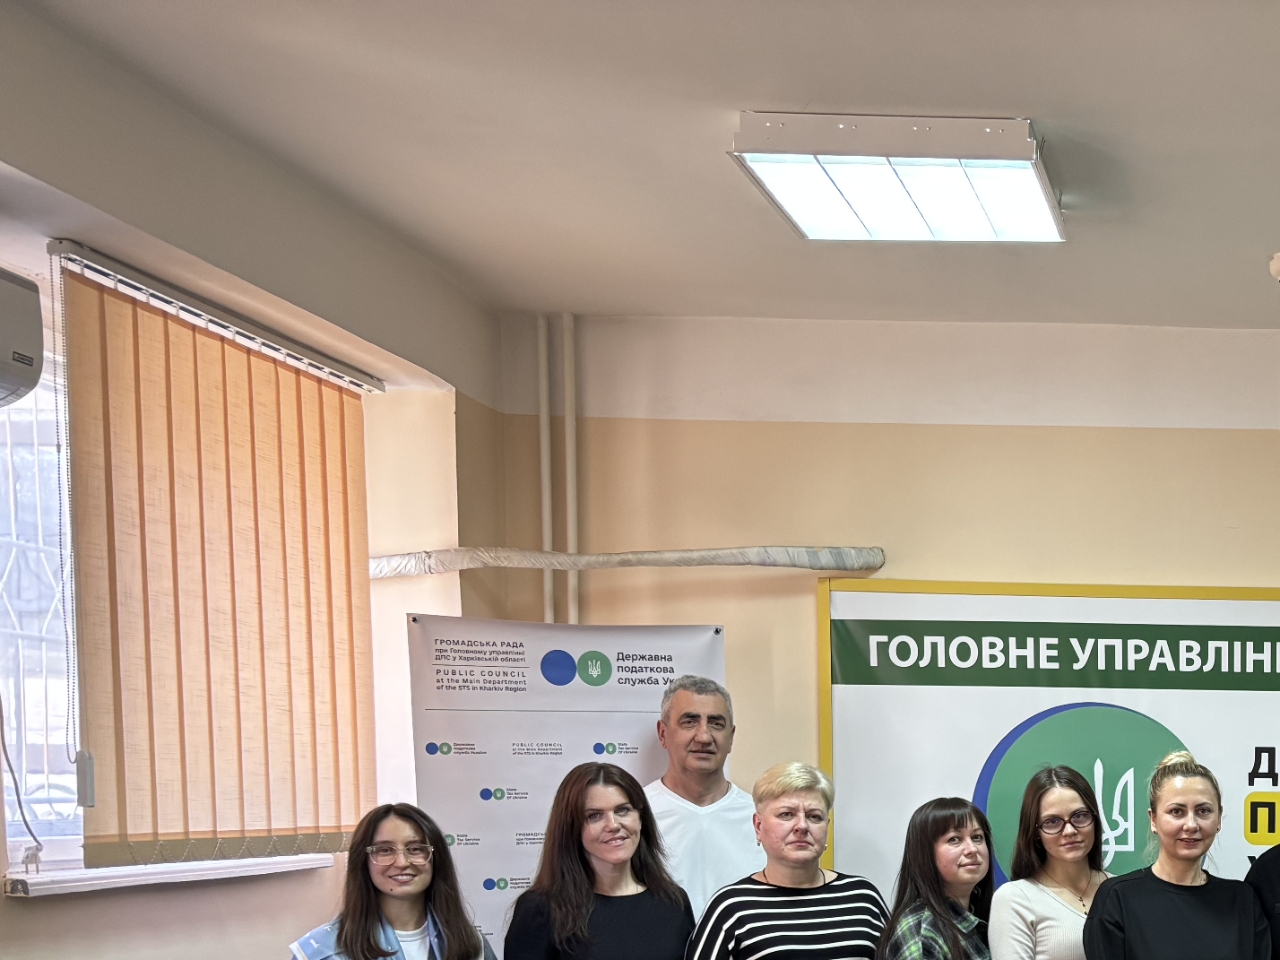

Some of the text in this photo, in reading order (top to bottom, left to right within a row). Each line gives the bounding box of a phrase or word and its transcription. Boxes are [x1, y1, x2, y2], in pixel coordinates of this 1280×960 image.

[434, 639, 525, 649] ГРОМАДСЬКА РАДА
[868, 634, 1060, 670] ГОЛОВНЕ
[616, 652, 673, 663] Державна
[436, 669, 527, 678] PUBLIC COUNCIL
[616, 665, 675, 674] податкова
[617, 676, 660, 687] служба
